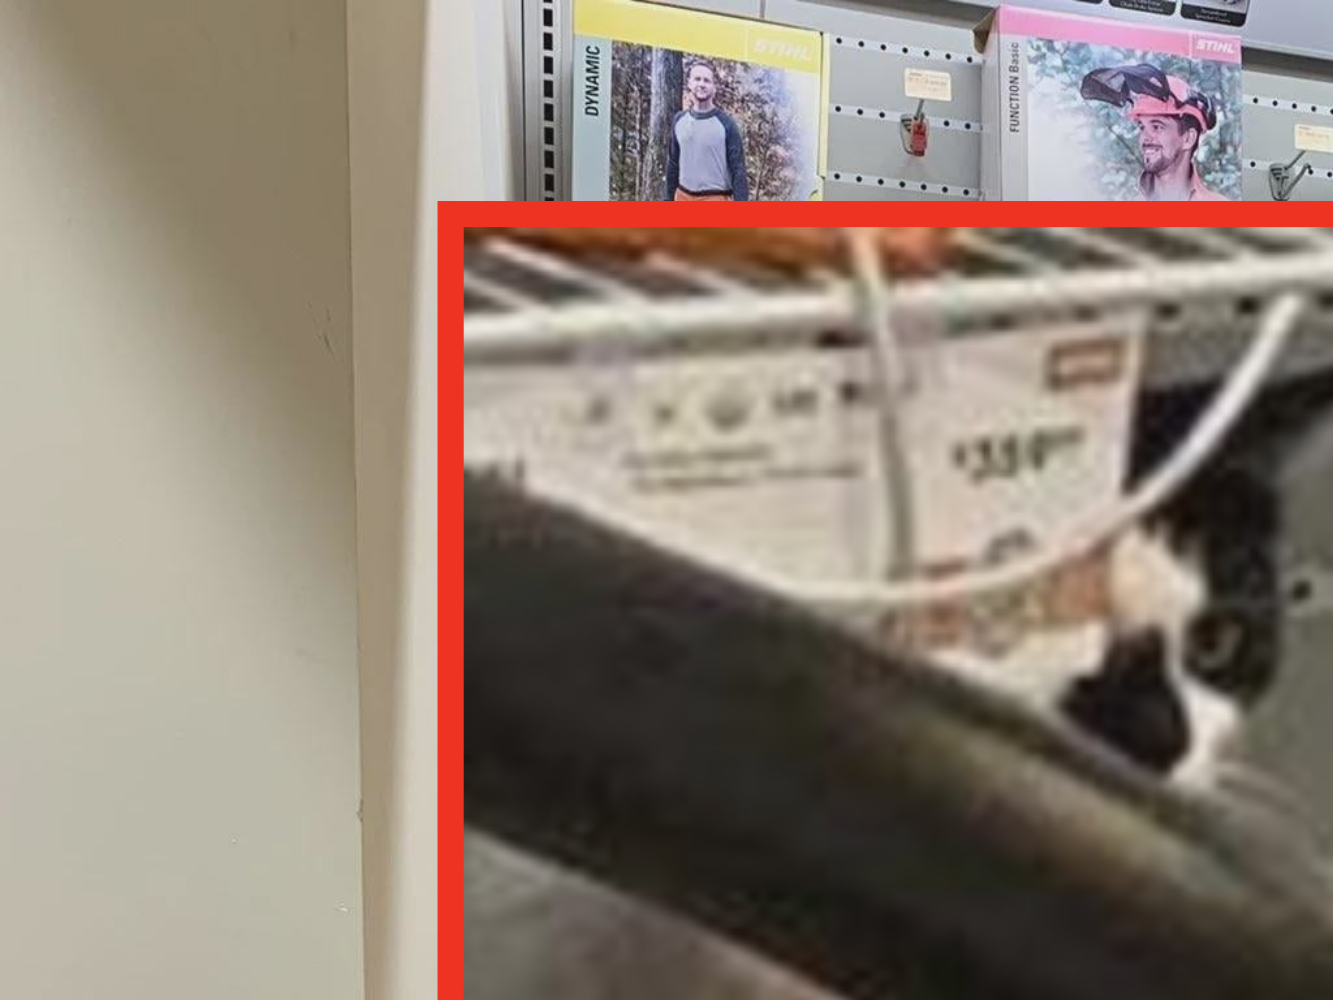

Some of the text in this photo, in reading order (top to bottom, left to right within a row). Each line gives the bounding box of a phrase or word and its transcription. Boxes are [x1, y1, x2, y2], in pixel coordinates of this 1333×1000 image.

[756, 39, 812, 60] STIHL
[1197, 39, 1234, 54] STIHL
[585, 45, 600, 116] DYNAMIC
[1008, 42, 1021, 132] FUNCTION Basic
